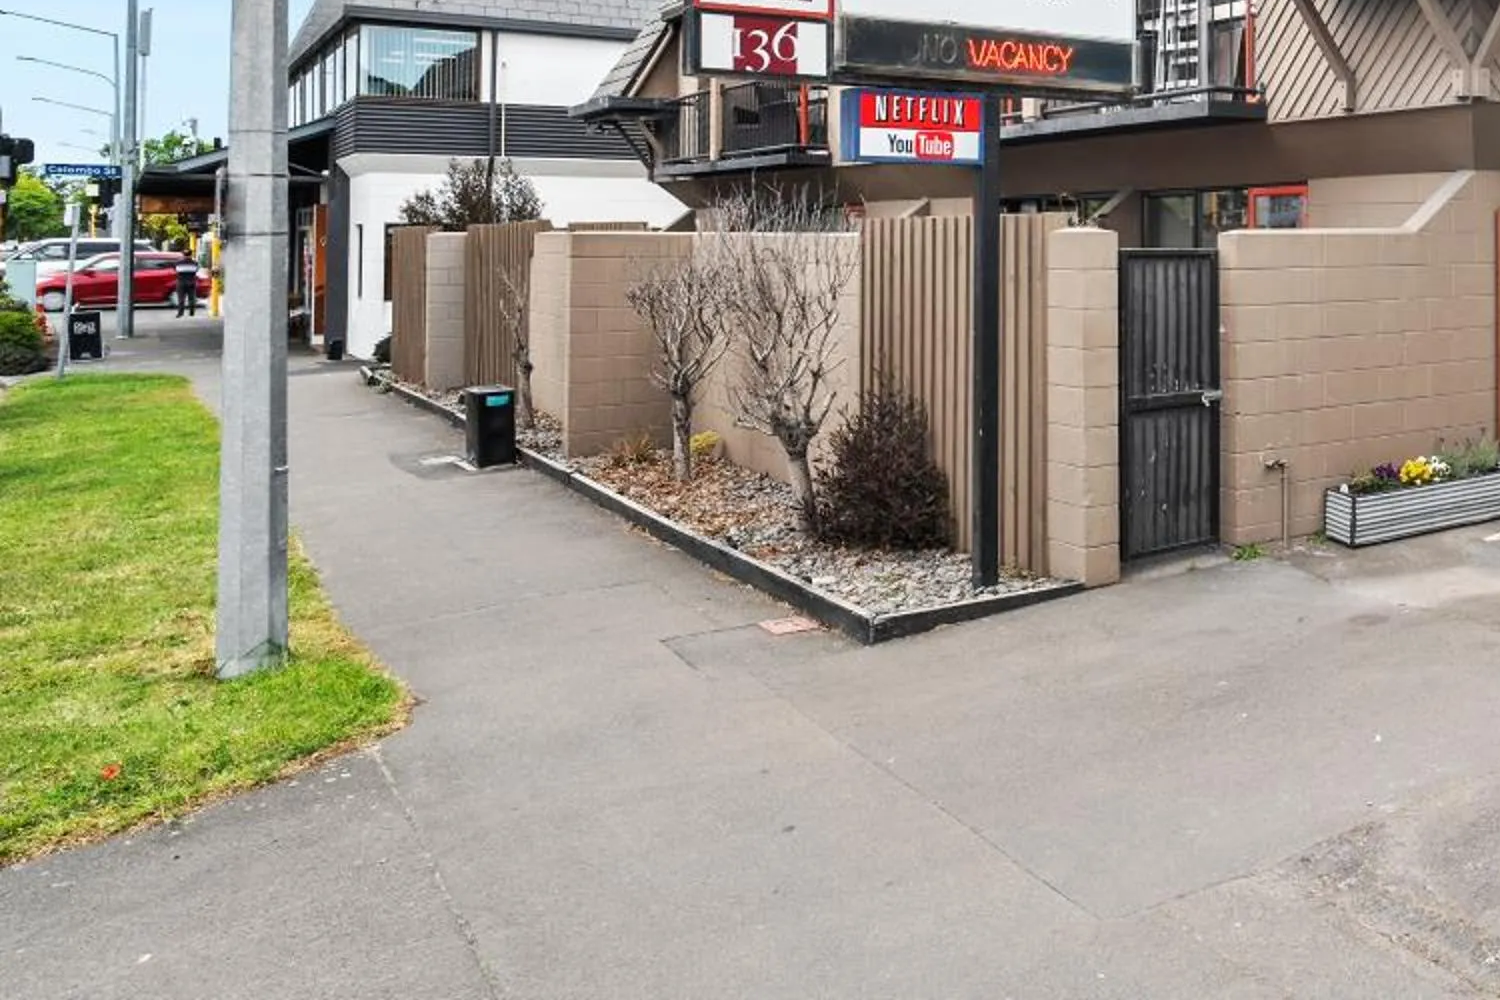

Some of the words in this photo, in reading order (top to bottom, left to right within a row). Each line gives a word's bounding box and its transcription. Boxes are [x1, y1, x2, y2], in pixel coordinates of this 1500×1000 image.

[733, 21, 800, 73] 136
[922, 32, 958, 64] NO
[967, 38, 1074, 73] VACANCY
[875, 95, 965, 127] NETFLIX
